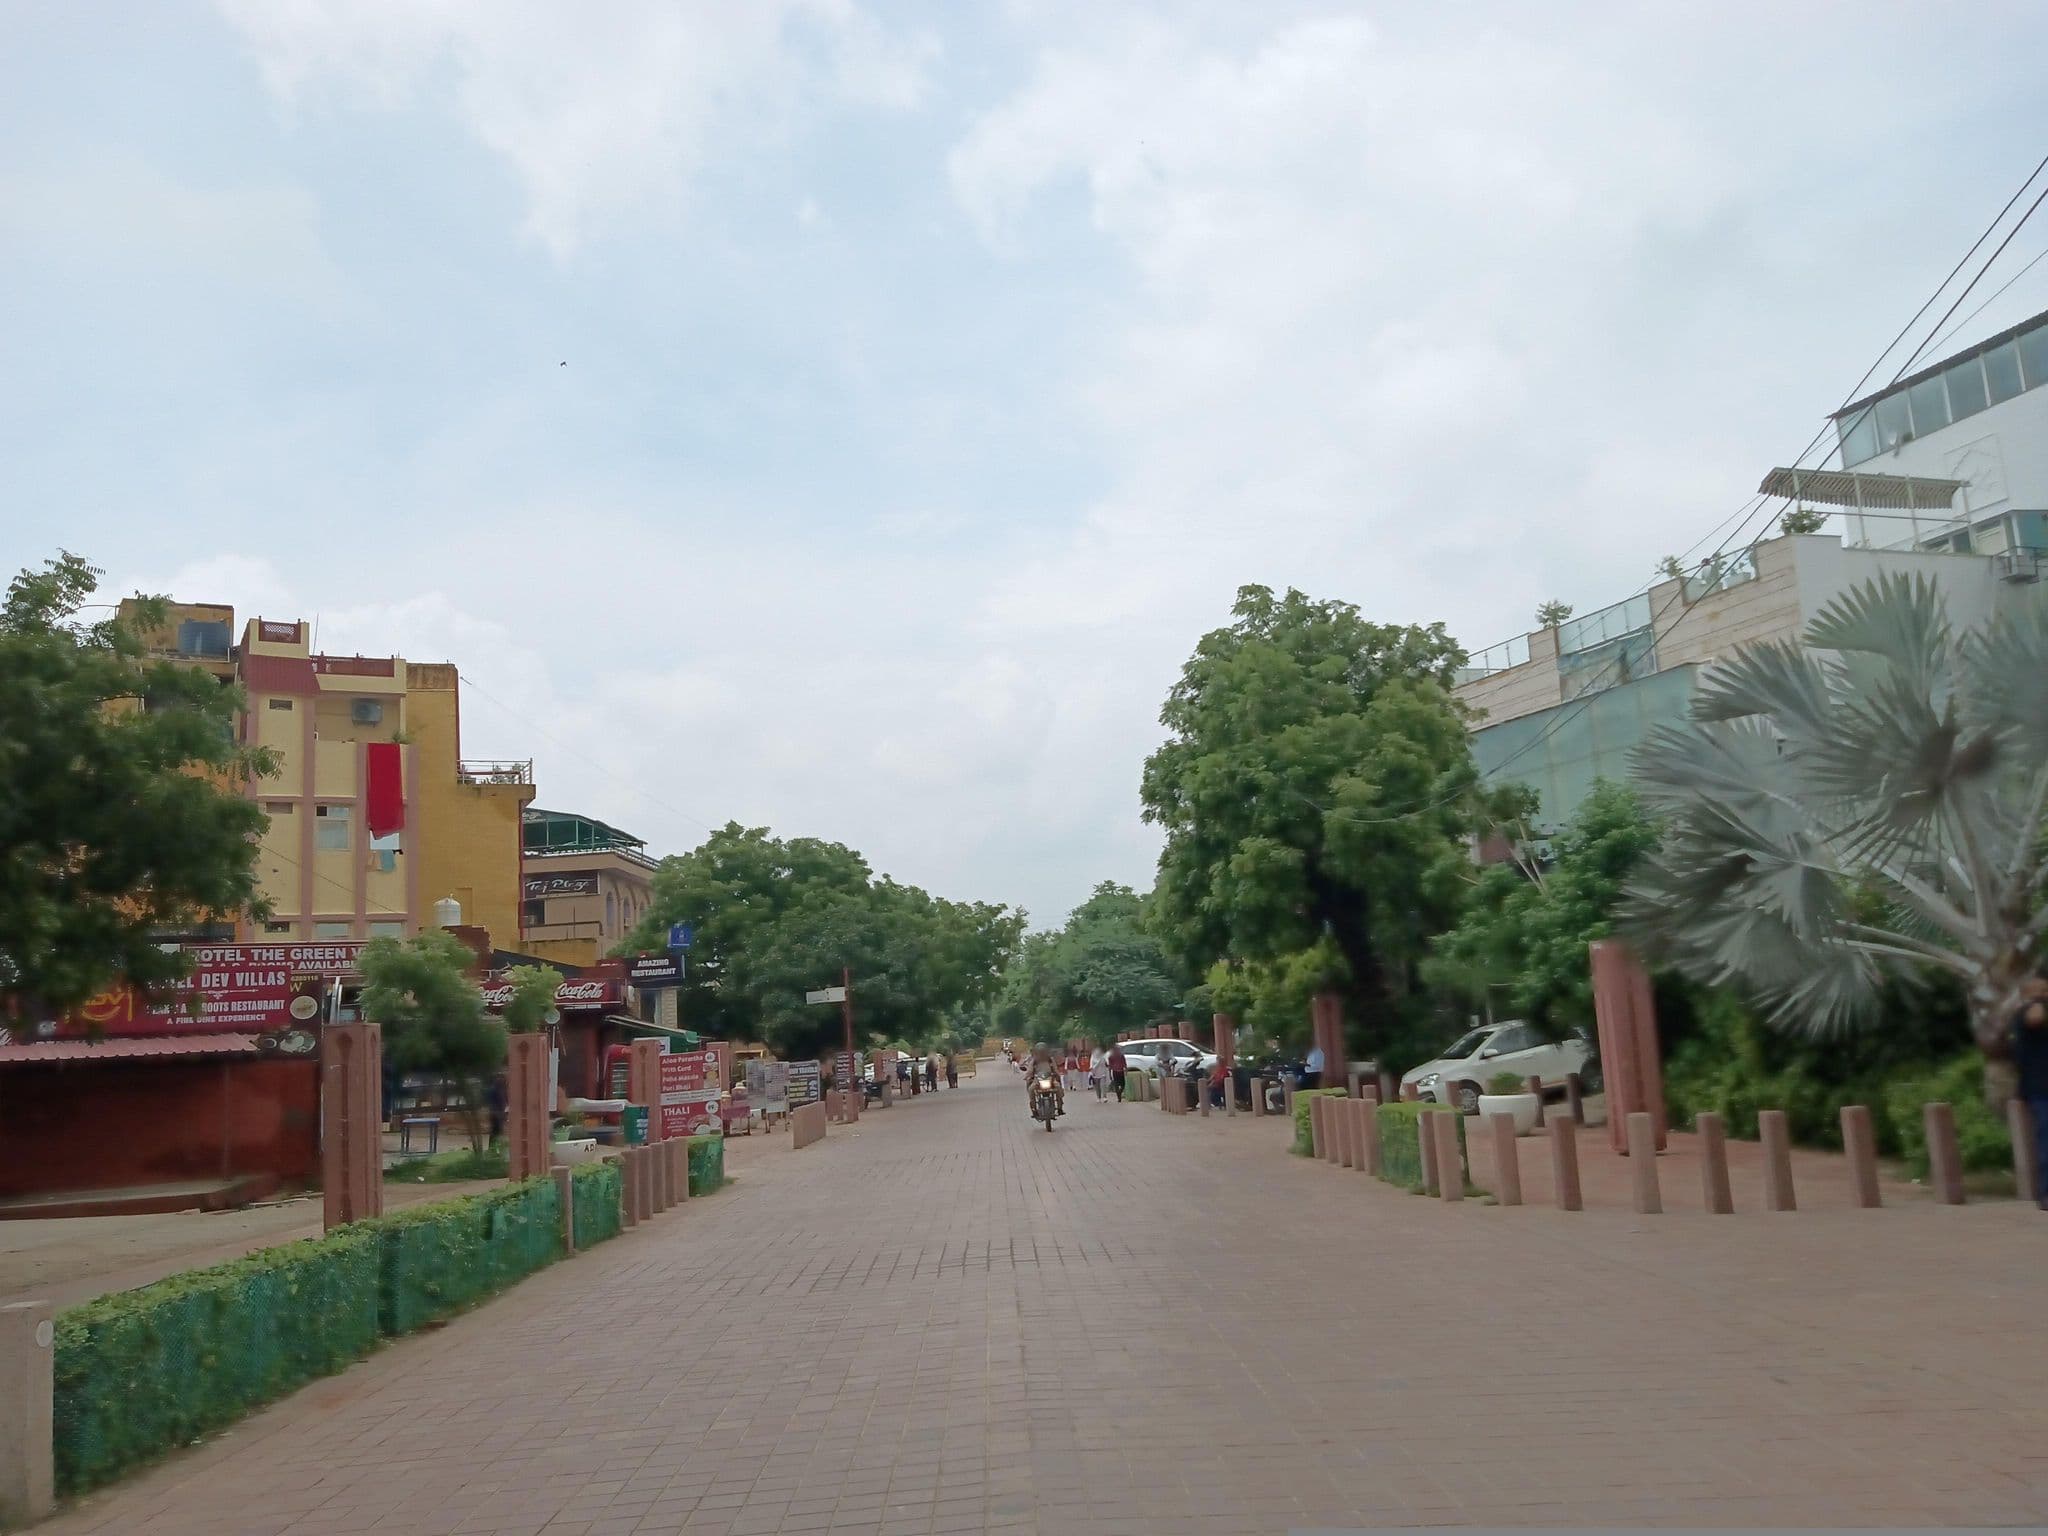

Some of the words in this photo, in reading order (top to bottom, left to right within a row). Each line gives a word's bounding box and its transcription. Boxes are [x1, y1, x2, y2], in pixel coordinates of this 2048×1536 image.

[251, 948, 285, 961] THE
[290, 947, 346, 960] GREEN
[202, 973, 229, 988] DEV
[236, 971, 286, 987] VILLAS
[230, 999, 285, 1012] RESTAURANT
[663, 1106, 690, 1117] THALI
